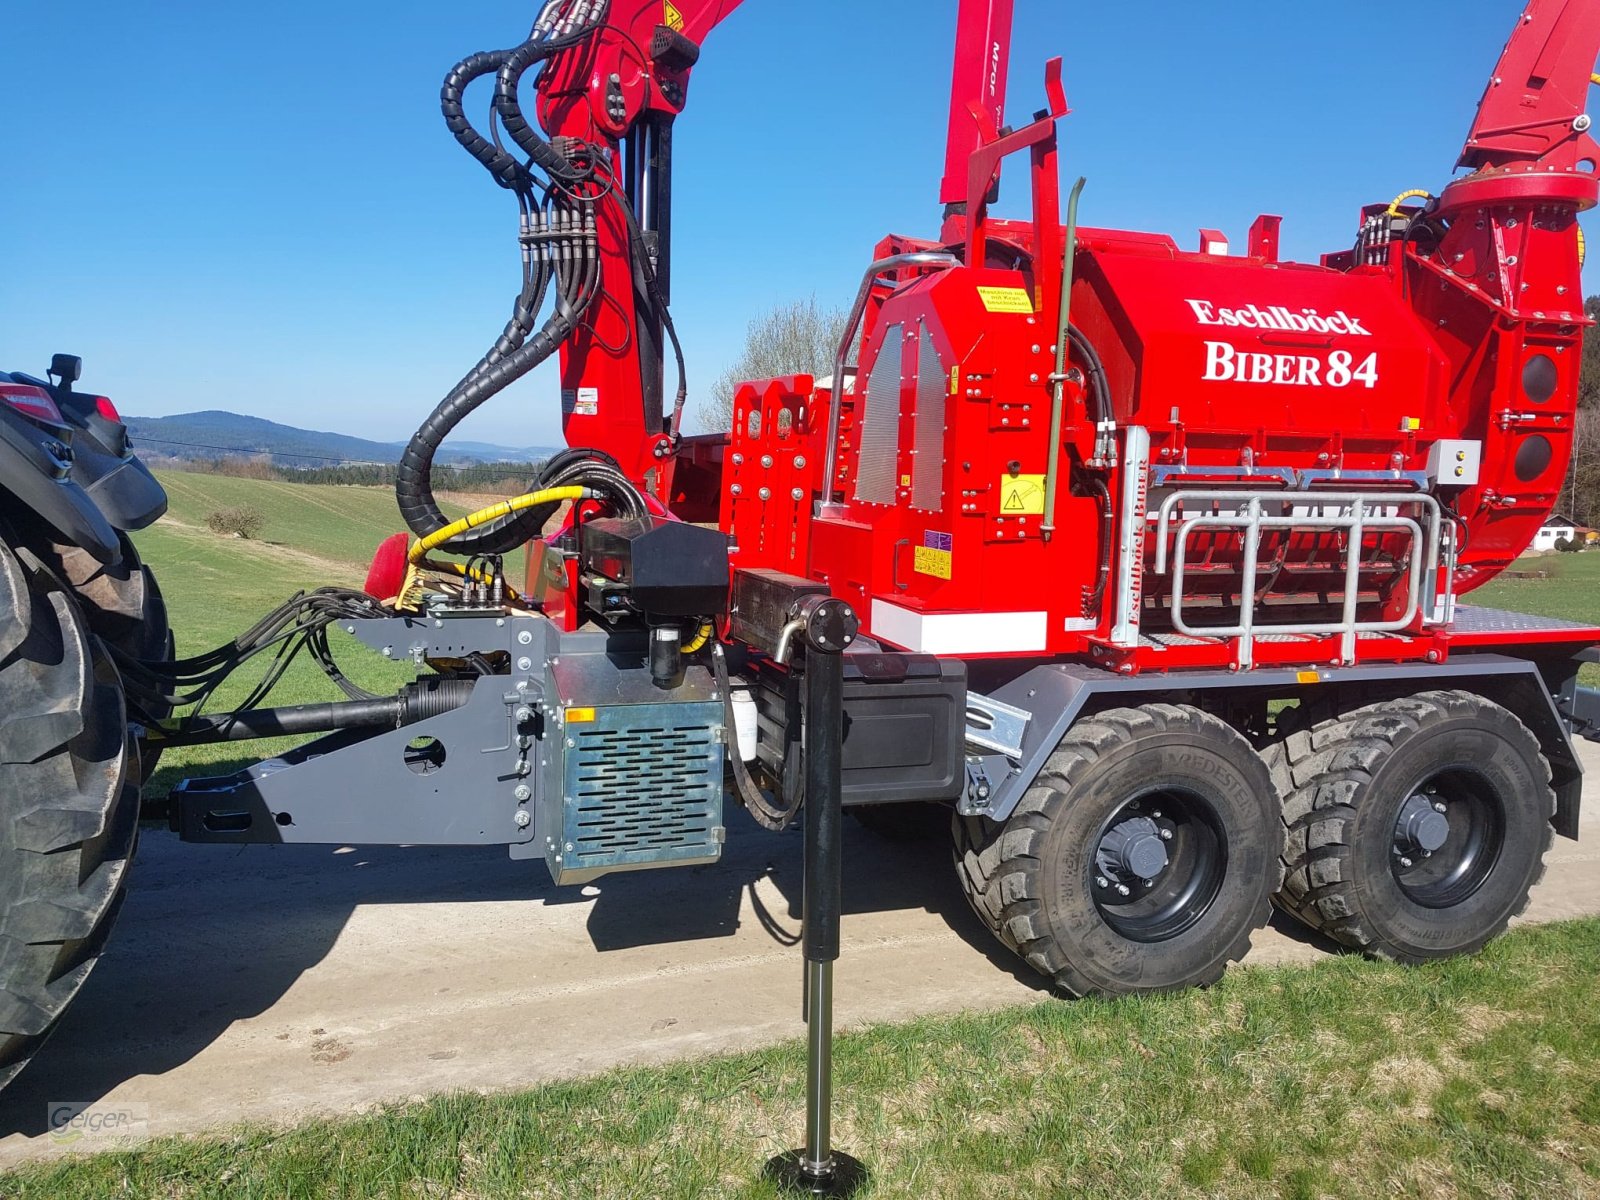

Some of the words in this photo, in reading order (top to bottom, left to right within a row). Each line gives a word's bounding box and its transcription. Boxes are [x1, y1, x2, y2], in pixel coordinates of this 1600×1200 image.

[989, 41, 1000, 97] M70F
[1184, 297, 1373, 337] Eschlböck
[1325, 349, 1379, 389] 84
[1128, 525, 1146, 627] Eschlböck
